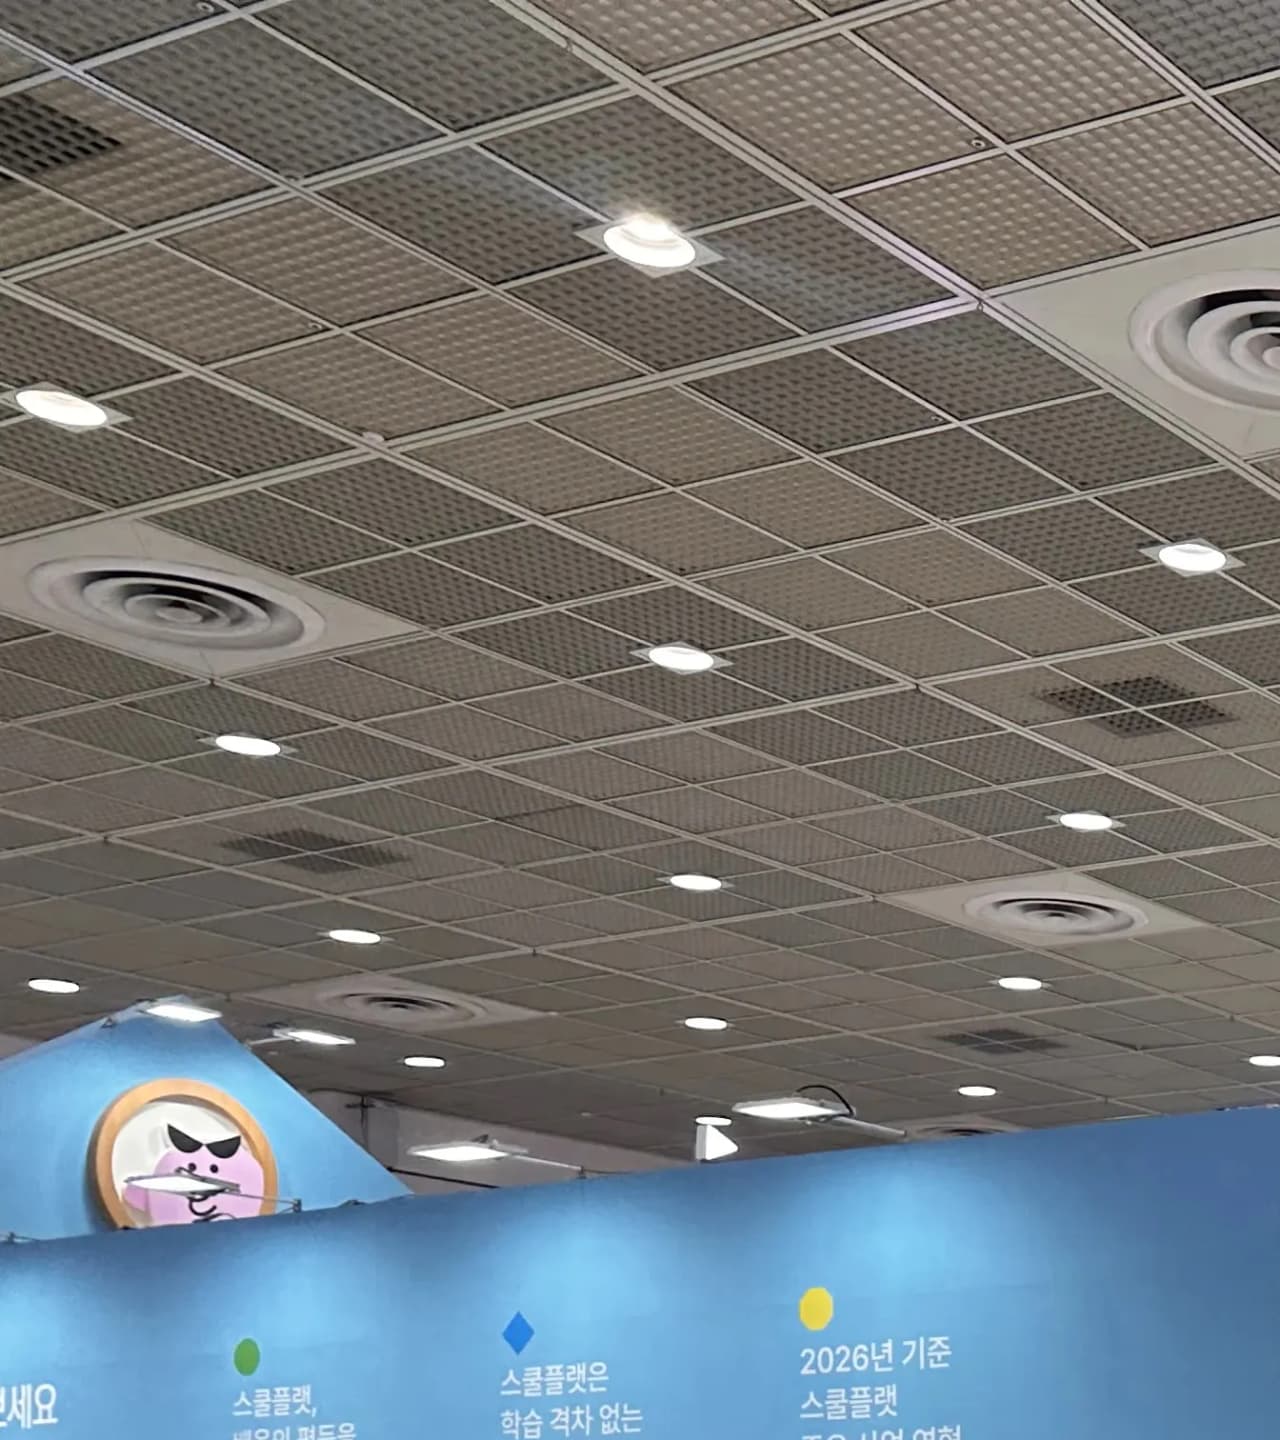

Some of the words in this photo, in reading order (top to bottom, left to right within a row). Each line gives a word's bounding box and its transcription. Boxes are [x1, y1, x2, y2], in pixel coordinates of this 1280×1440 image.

[799, 1338, 894, 1375] 2026년
[901, 1335, 953, 1371] 기준
[499, 1361, 610, 1398] 스쿨플랫은
[231, 1384, 319, 1419] 스쿨플랫,
[799, 1383, 899, 1421] 스쿨플랫
[500, 1407, 545, 1440] 학습
[550, 1403, 595, 1438] 격차
[599, 1402, 644, 1436] 없는
